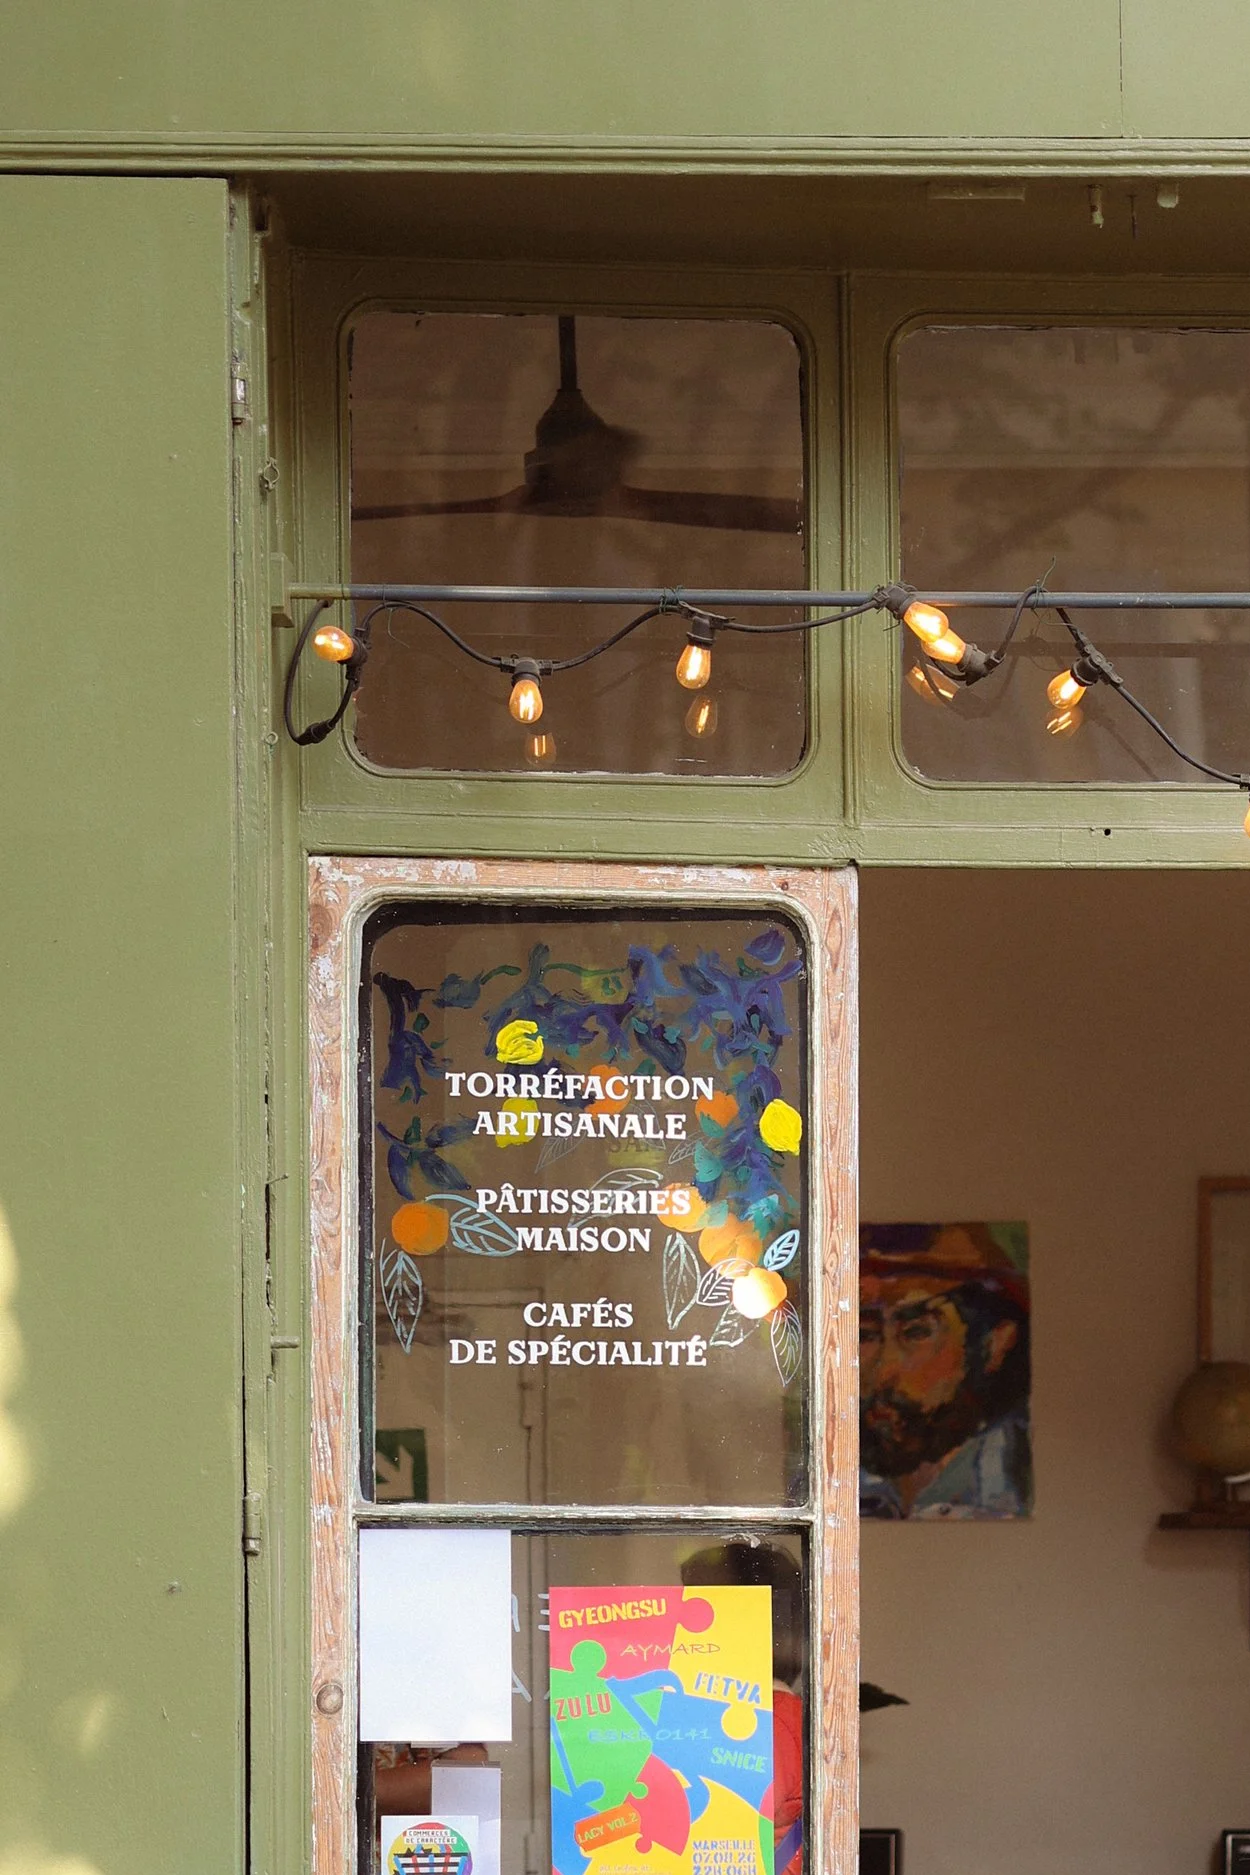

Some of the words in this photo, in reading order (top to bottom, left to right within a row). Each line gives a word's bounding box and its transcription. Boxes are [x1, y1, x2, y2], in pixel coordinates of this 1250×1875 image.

[445, 1067, 714, 1100] TORRÉFACTION
[472, 1111, 687, 1140] ARTISANALE
[476, 1182, 691, 1215] PÂTISSERIES
[516, 1227, 651, 1252] MAISON
[523, 1297, 634, 1328] CAFÉS
[449, 1339, 497, 1364] DE
[508, 1334, 707, 1367] SPÉCIALITÉ
[558, 1598, 667, 1629] GYEONGSU
[620, 1643, 721, 1662] AYMARD
[710, 1747, 769, 1774] SNICE
[693, 1840, 755, 1850] MARSEILLE
